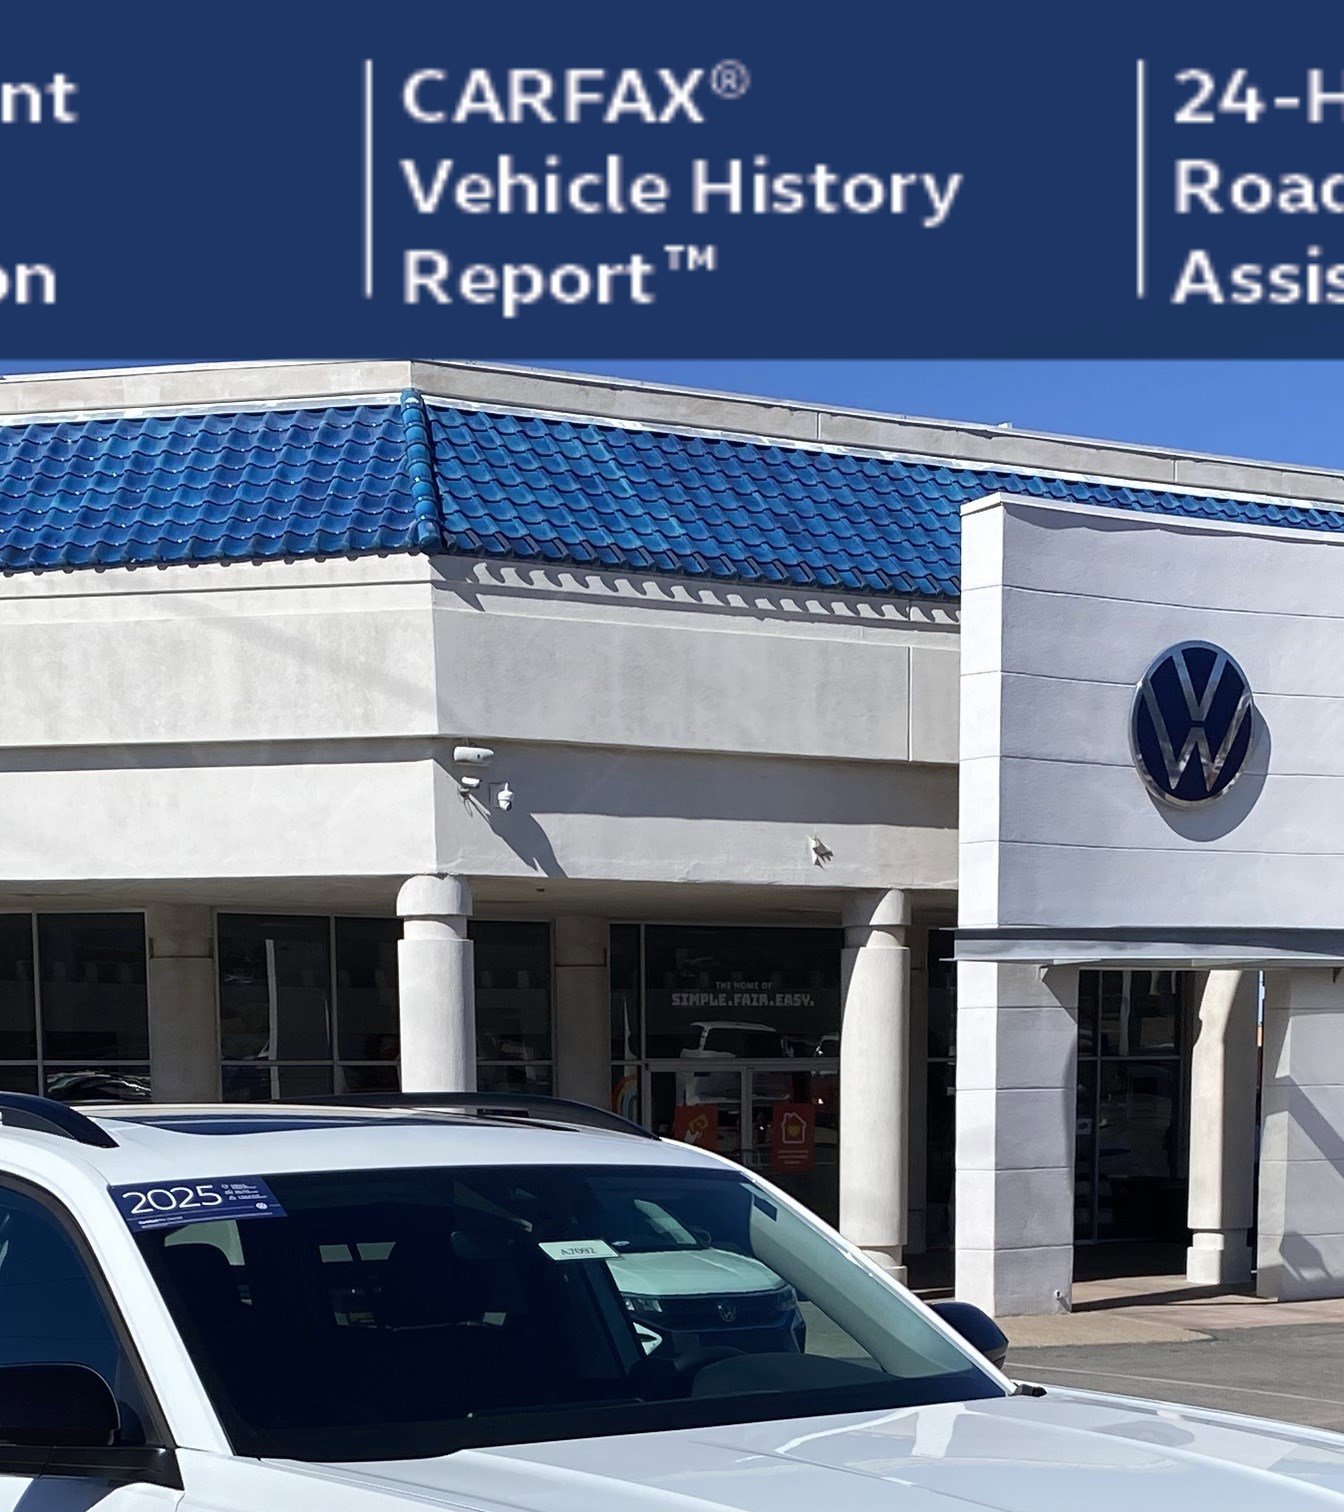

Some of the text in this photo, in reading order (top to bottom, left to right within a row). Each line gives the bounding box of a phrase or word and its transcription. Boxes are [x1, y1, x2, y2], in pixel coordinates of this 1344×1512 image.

[715, 981, 773, 990] THE HOME OF
[122, 1184, 223, 1215] 2025
